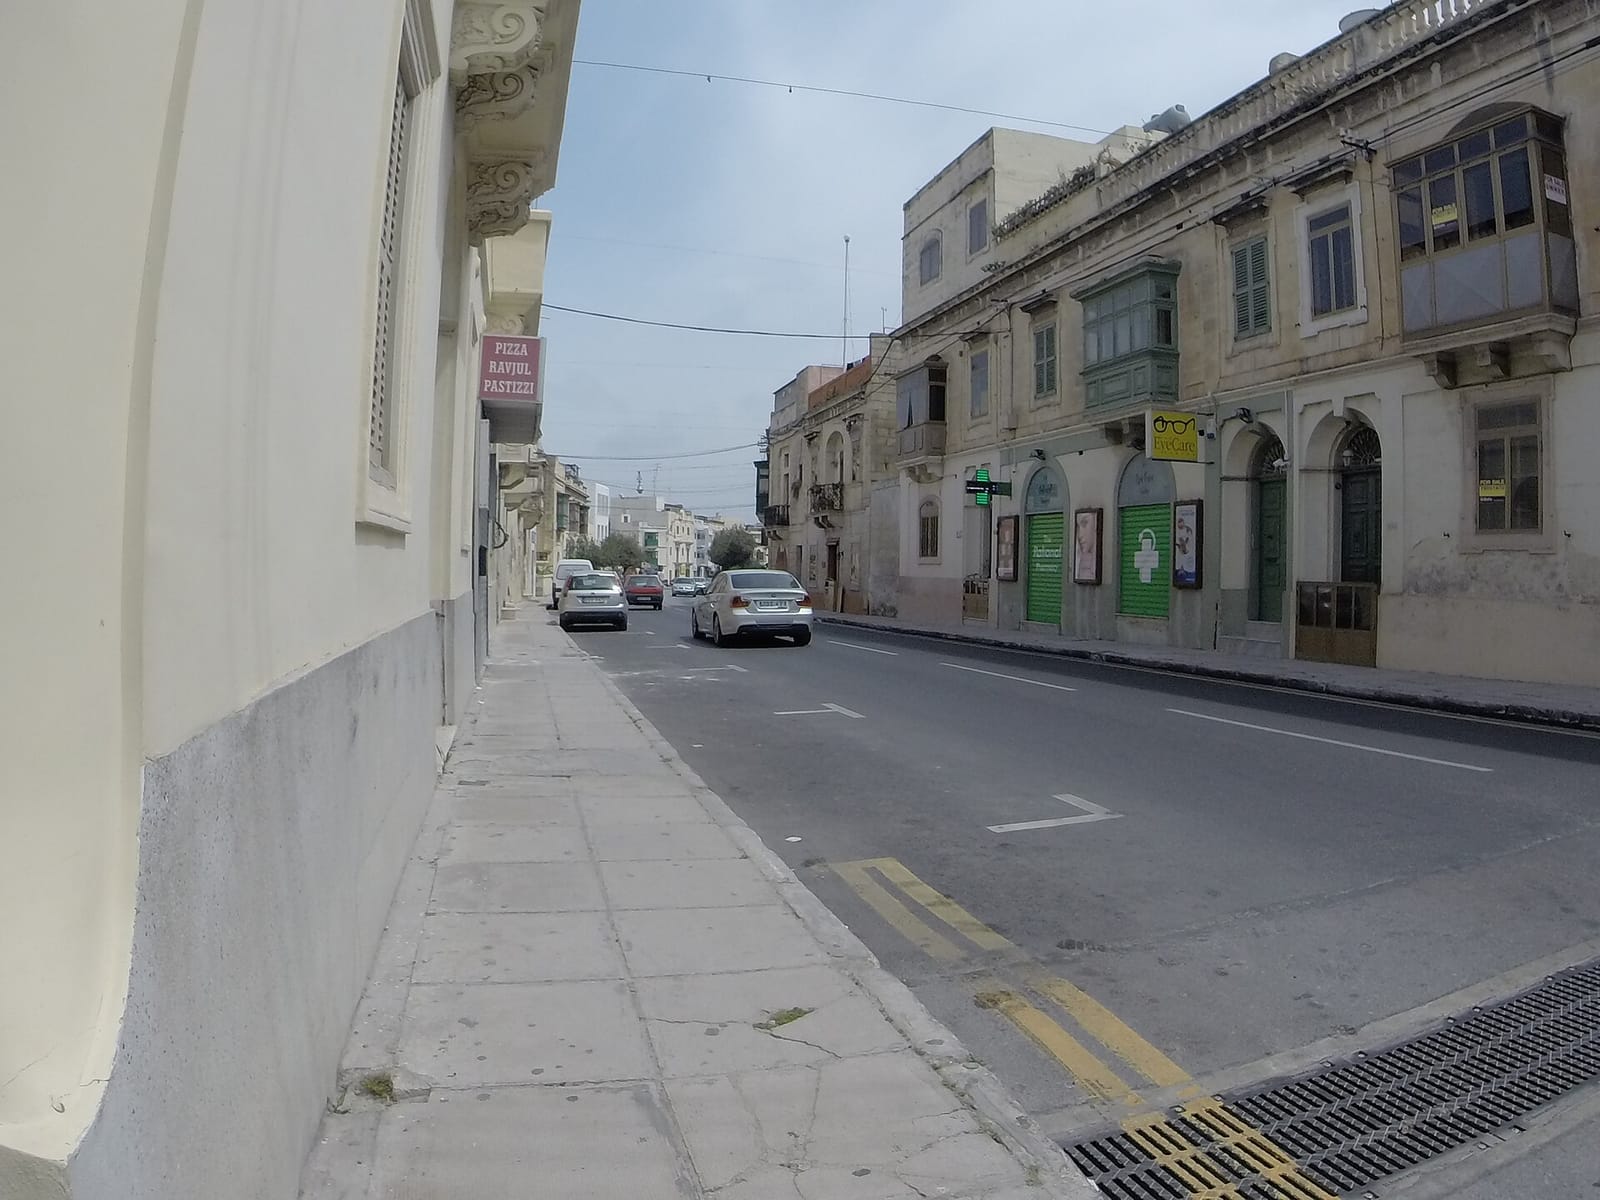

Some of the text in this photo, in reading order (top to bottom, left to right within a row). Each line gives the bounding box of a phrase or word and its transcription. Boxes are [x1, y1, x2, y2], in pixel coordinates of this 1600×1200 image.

[495, 342, 528, 356] PIZZA
[489, 360, 532, 376] RAVJUL
[484, 379, 535, 395] PASTIZZI
[1154, 436, 1195, 453] EyeCare
